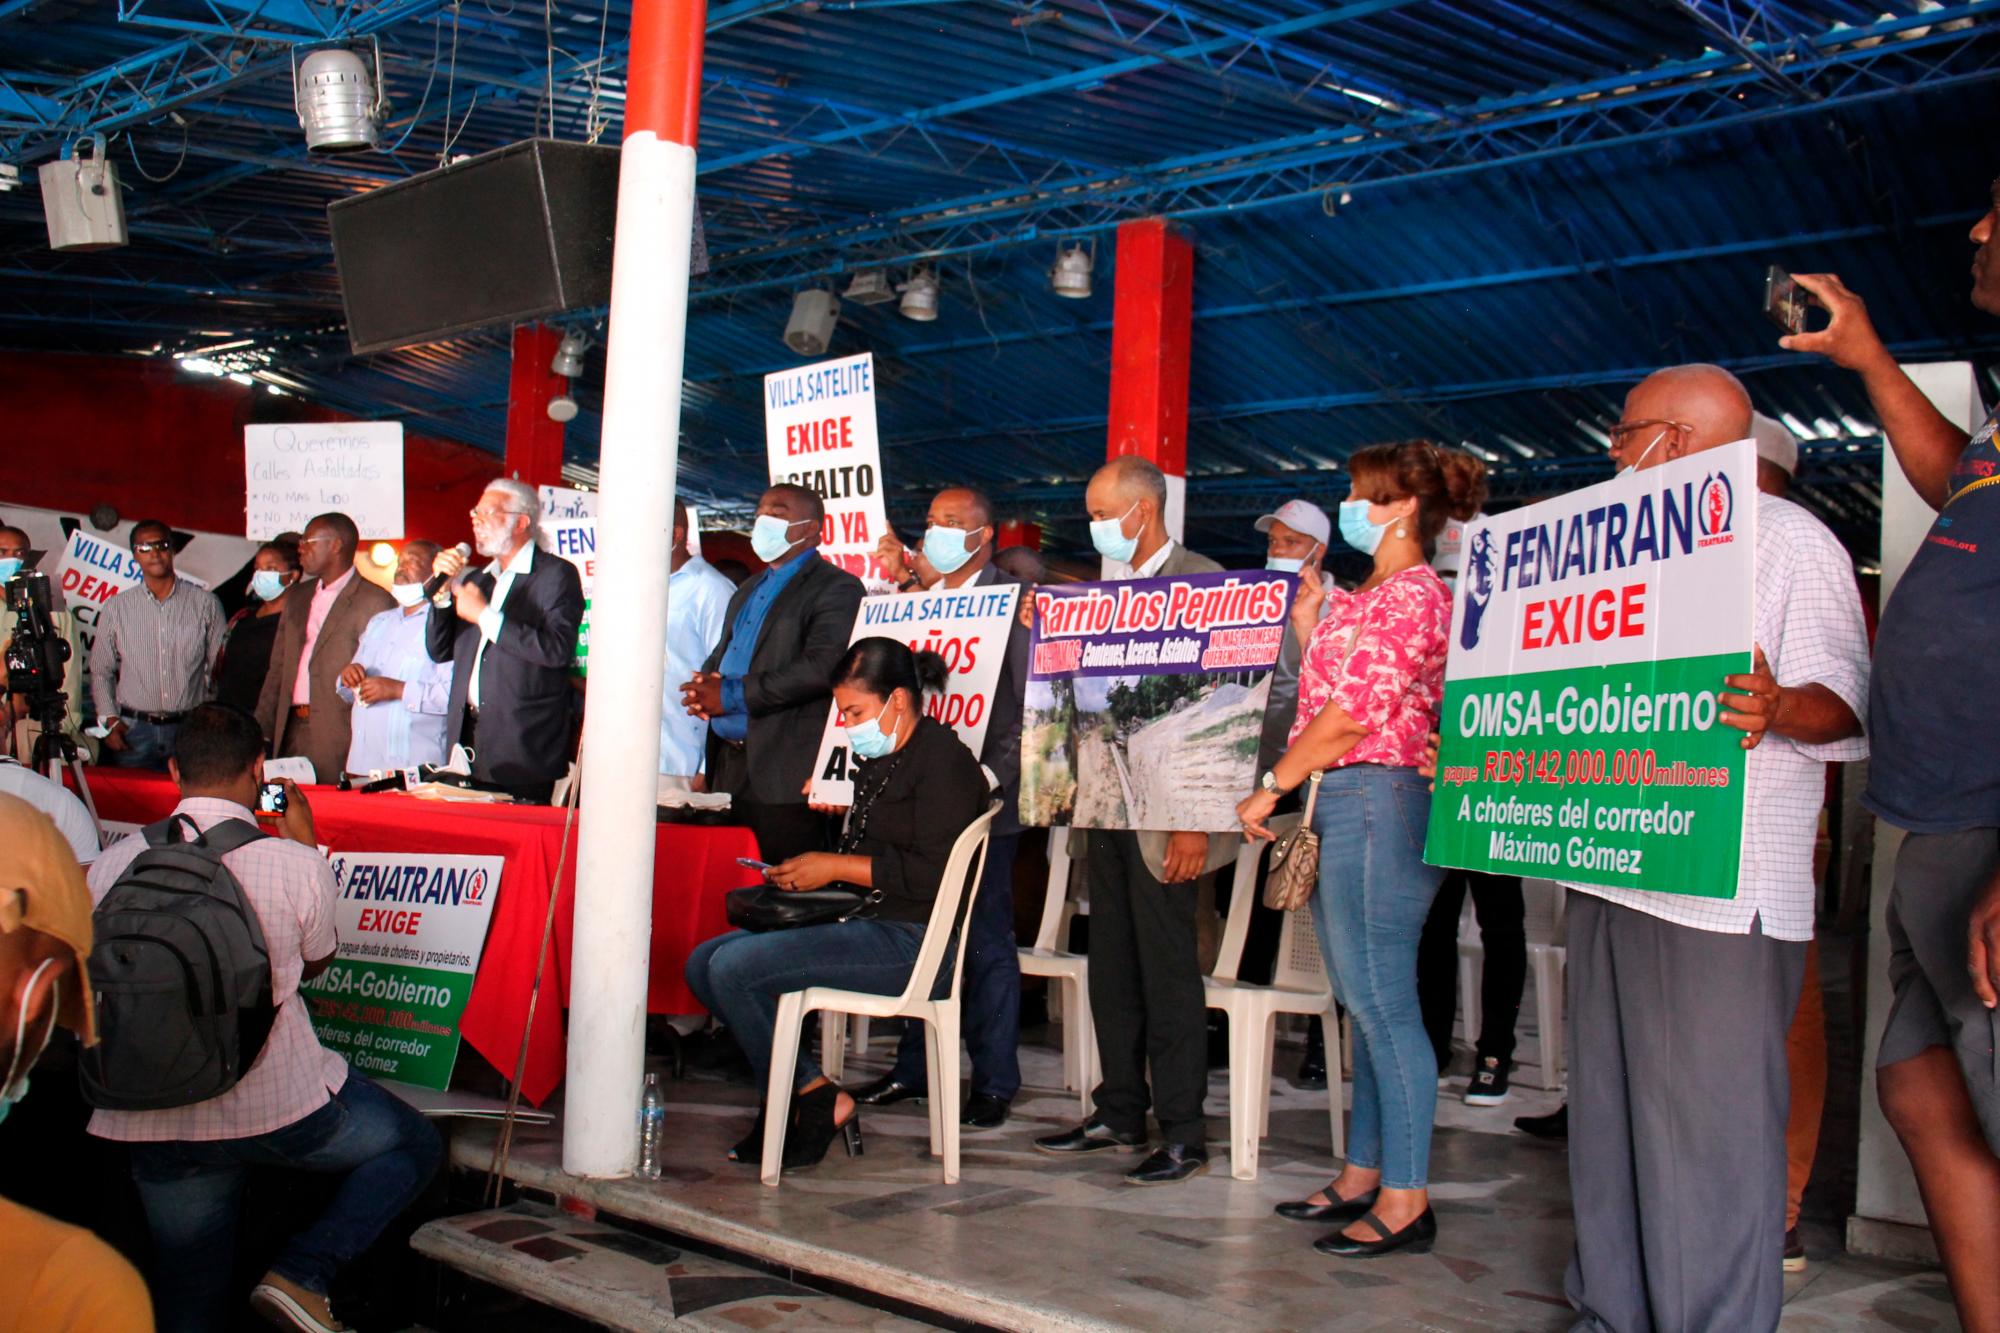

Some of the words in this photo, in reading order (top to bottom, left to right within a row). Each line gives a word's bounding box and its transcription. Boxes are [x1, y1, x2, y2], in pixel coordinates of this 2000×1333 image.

[769, 376, 804, 409] VILLA
[807, 363, 870, 402] SATELITE
[273, 426, 370, 452] Queremos
[786, 416, 853, 456] EXIGE
[253, 460, 290, 481] Calles
[841, 511, 869, 544] YA
[73, 536, 123, 574] VILLA
[864, 600, 914, 625] VILLA
[918, 594, 1011, 621] SATELITE
[1036, 589, 1115, 639] Barrio
[1111, 586, 1167, 633] Los
[1163, 579, 1288, 632] Pepines
[1521, 583, 1646, 650] EXIGE
[1459, 682, 1716, 738] OMSA-Gobierno
[1442, 765, 1478, 786] pague
[1457, 794, 1471, 822] A
[1475, 795, 1553, 827] choferes
[1558, 798, 1589, 829] del
[1594, 801, 1695, 836] corredor
[1488, 830, 1561, 866] Máximo
[1566, 836, 1643, 875] Gómez
[357, 908, 422, 935] EXIGE
[381, 944, 390, 957] de
[390, 945, 419, 960] choferes
[419, 951, 427, 964] y
[354, 1030, 373, 1047] del
[375, 1034, 431, 1057] corredor
[355, 1050, 399, 1073] Gómez
